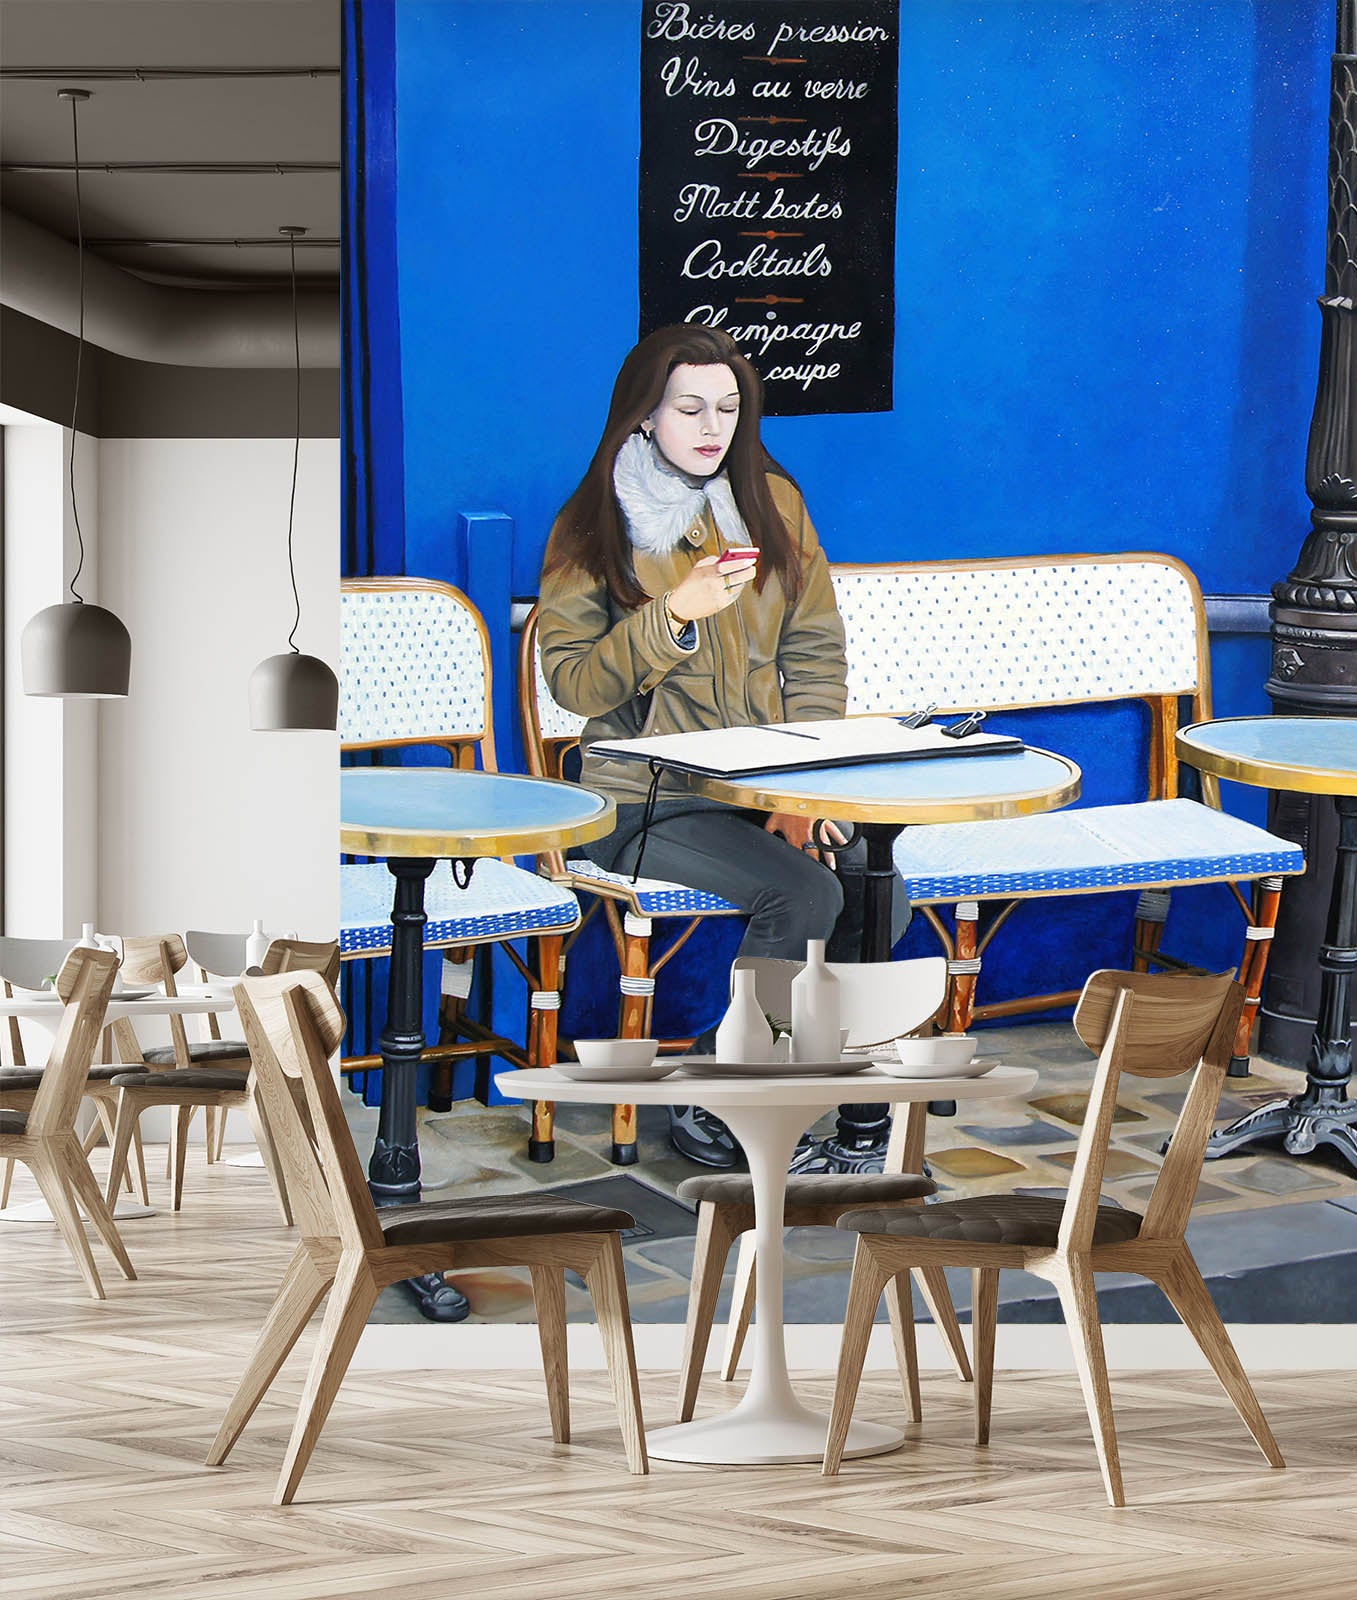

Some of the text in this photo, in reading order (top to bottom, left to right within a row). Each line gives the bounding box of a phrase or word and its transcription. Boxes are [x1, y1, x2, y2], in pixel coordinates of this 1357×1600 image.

[647, 2, 890, 56] Bières pression
[660, 55, 869, 100] Vins au verre
[694, 118, 851, 171] Digestifs
[673, 183, 843, 223] Matt bates
[680, 239, 832, 280] Cocktails
[763, 362, 841, 391] coupe
